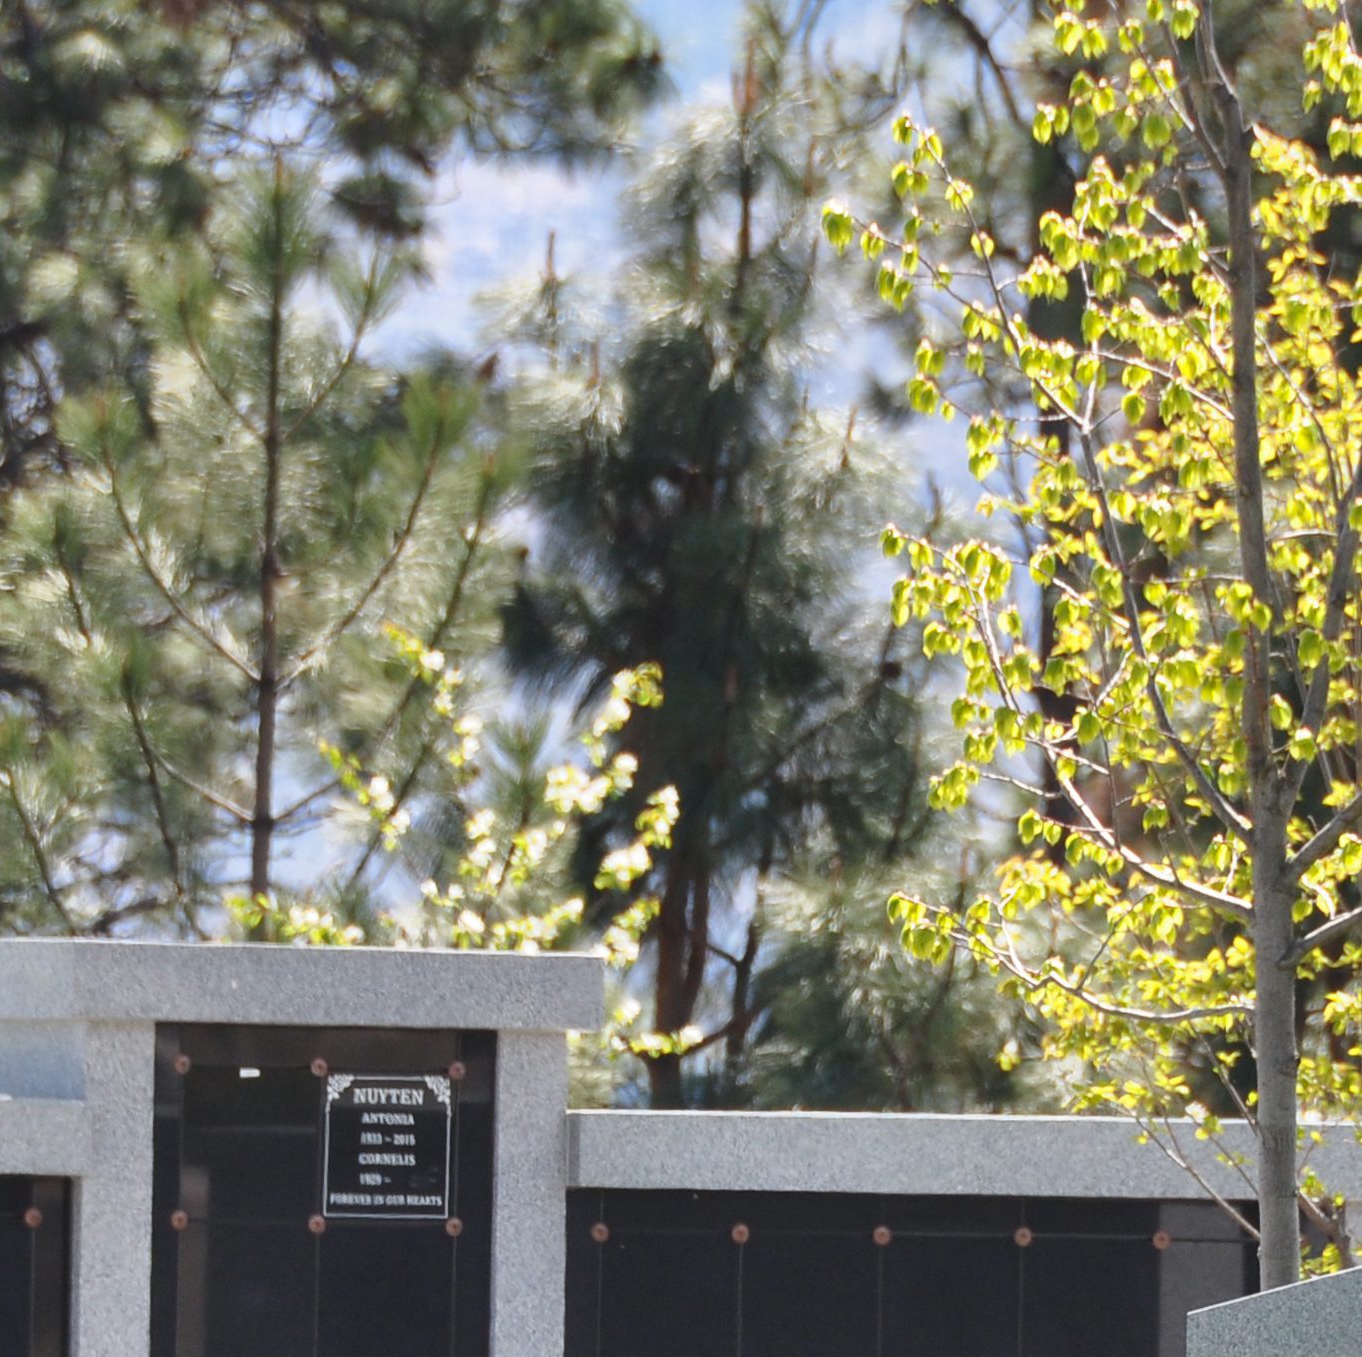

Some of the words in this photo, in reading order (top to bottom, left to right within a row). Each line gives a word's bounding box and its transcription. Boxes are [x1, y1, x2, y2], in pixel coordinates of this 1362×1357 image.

[353, 1088, 425, 1105] NUYTEN
[362, 1112, 415, 1126] ANTONIA
[358, 1153, 417, 1166] CORNELIS
[330, 1193, 371, 1206] FOREVER
[373, 1195, 385, 1205] IN
[386, 1194, 405, 1205] OUR
[407, 1195, 442, 1206] HEARTS
